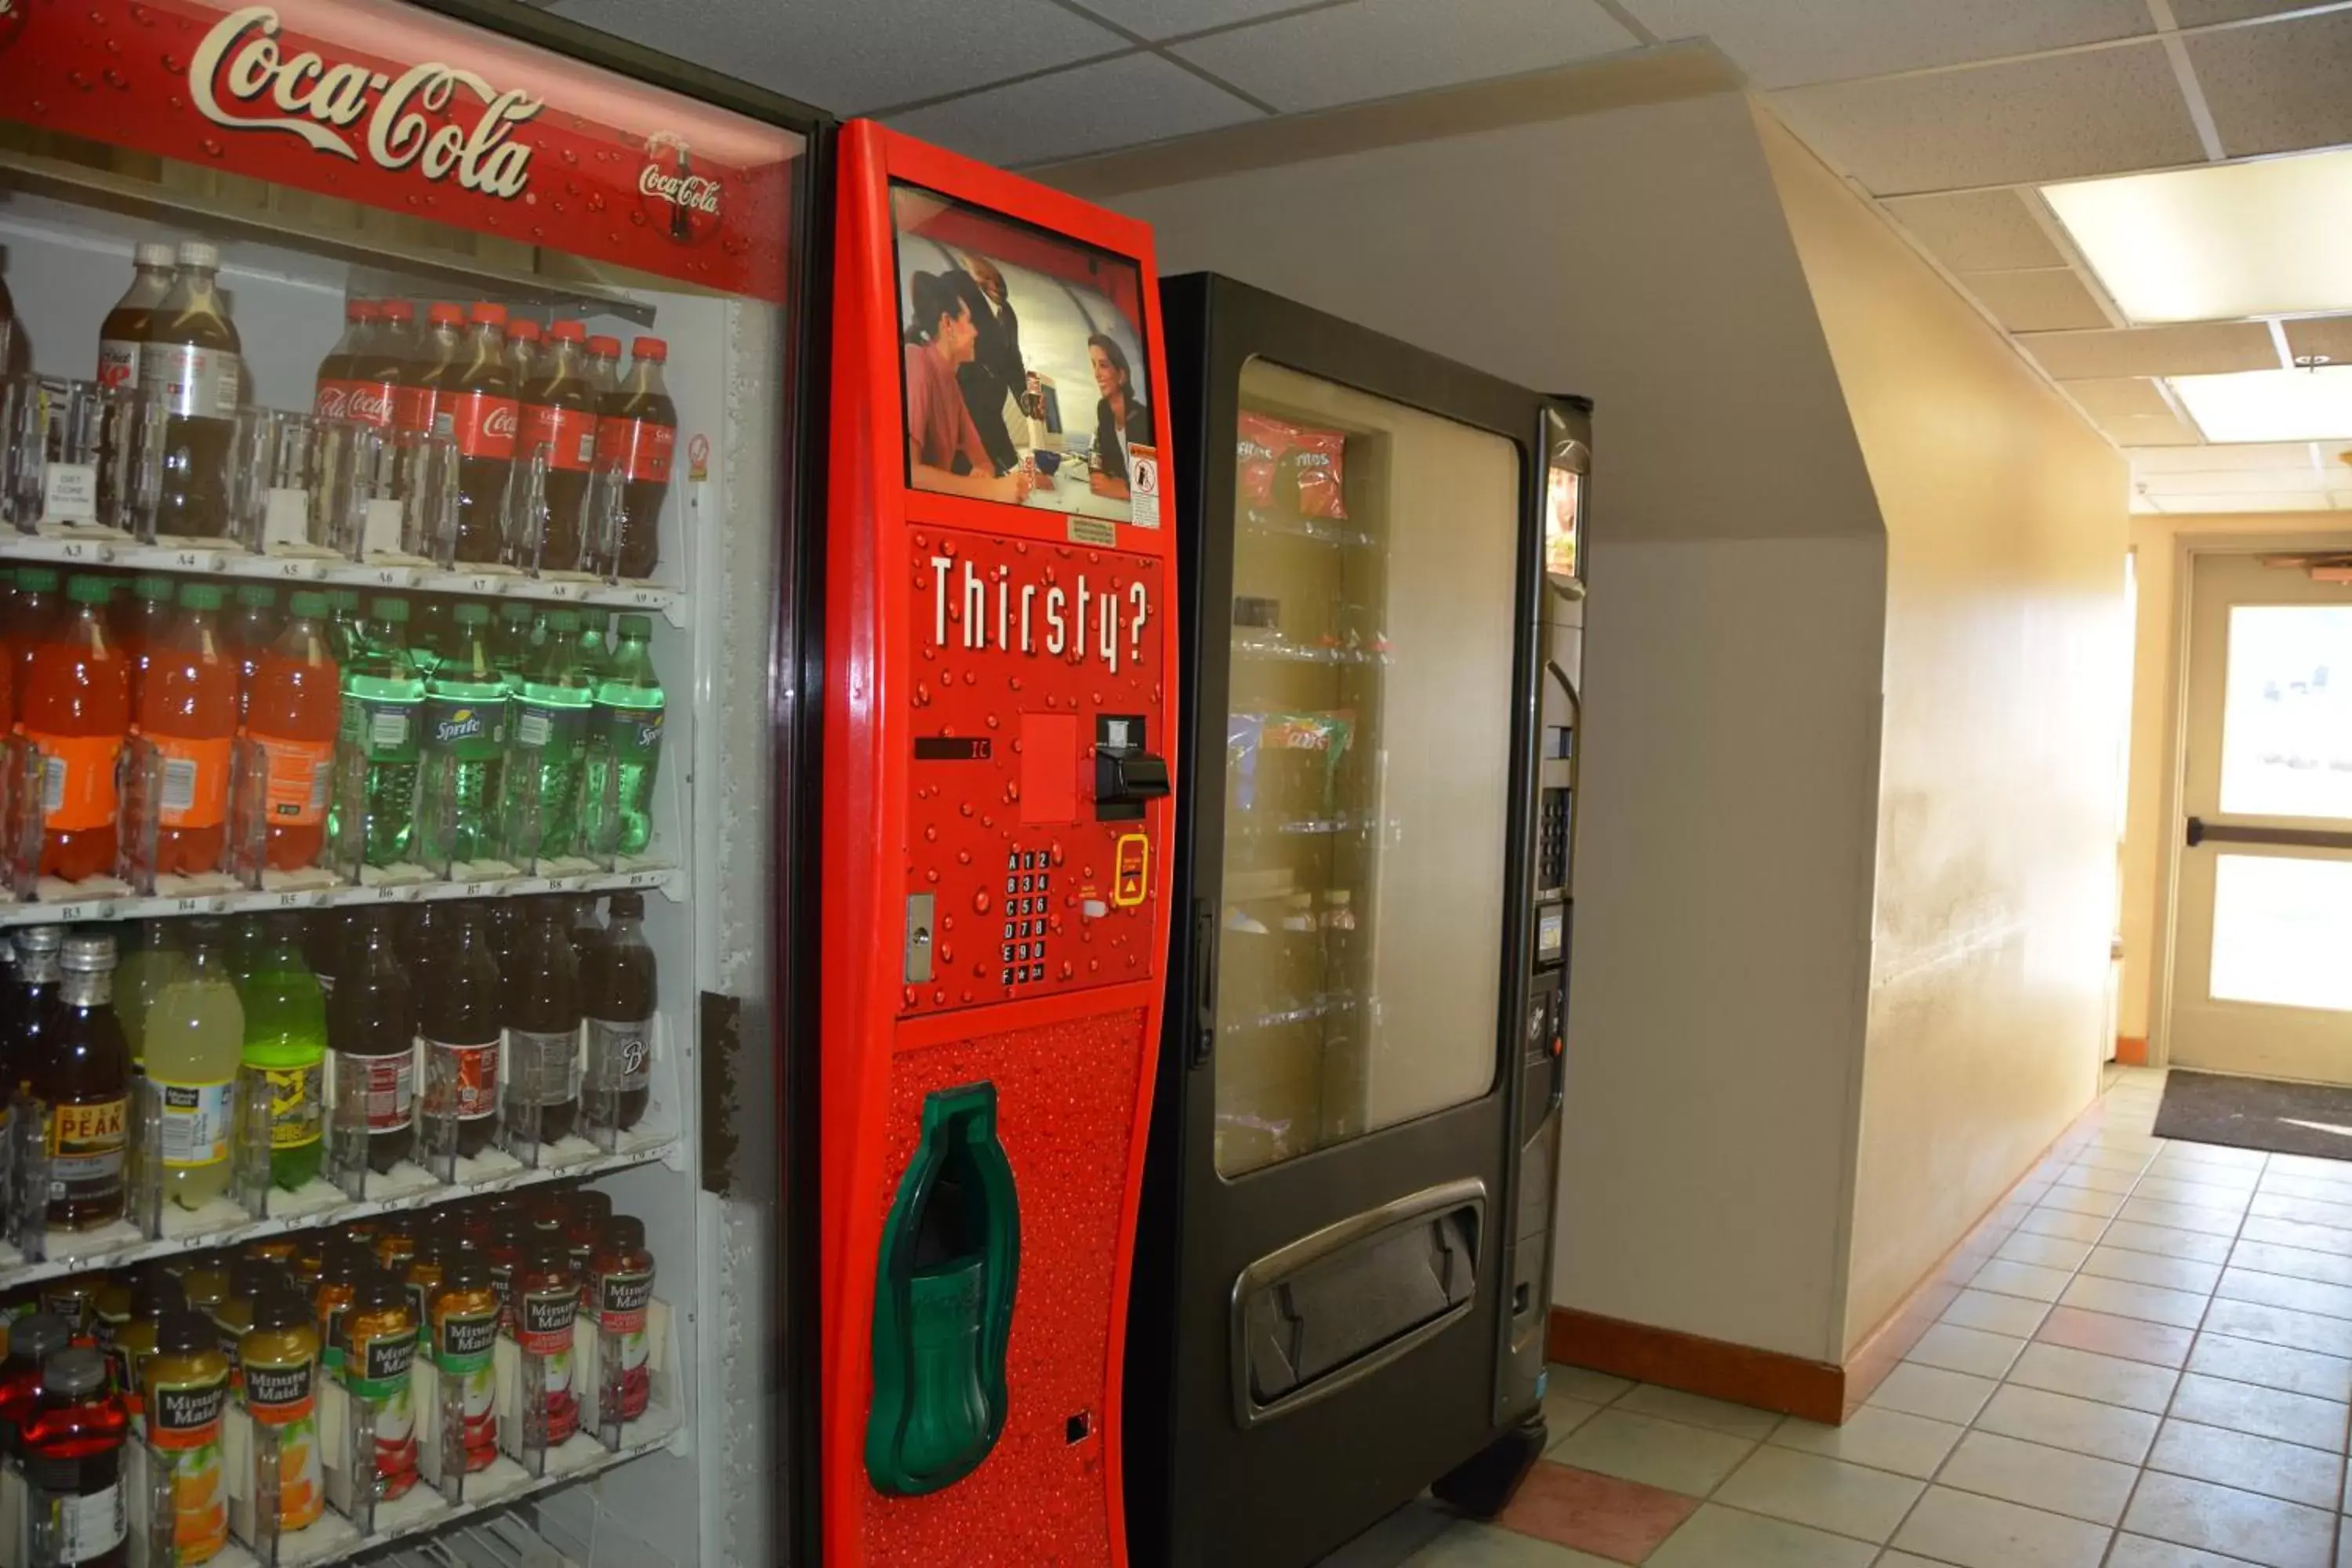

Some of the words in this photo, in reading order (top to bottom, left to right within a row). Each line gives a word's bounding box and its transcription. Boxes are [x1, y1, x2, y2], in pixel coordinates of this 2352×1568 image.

[188, 6, 544, 198] Coca-Cola
[639, 163, 720, 213] Coca-Cola
[63, 546, 82, 557] A3
[177, 554, 194, 565] A4
[931, 557, 1147, 673] Thirsty?
[436, 719, 481, 741] Sprite
[1009, 855, 1016, 869] A
[1025, 854, 1030, 868] 1
[1039, 853, 1046, 868] 2
[1023, 877, 1029, 891] 3
[179, 899, 195, 911] B4
[280, 895, 296, 905] B5
[1007, 901, 1014, 916] C
[1022, 899, 1029, 913] 5
[1037, 898, 1044, 913] 6
[63, 908, 80, 920] B3
[1022, 922, 1027, 936] 7
[1036, 920, 1042, 935] 8
[1004, 946, 1011, 961] E
[1020, 945, 1026, 959] 9
[61, 1115, 120, 1138] PEAK
[258, 1385, 299, 1400] Maid
